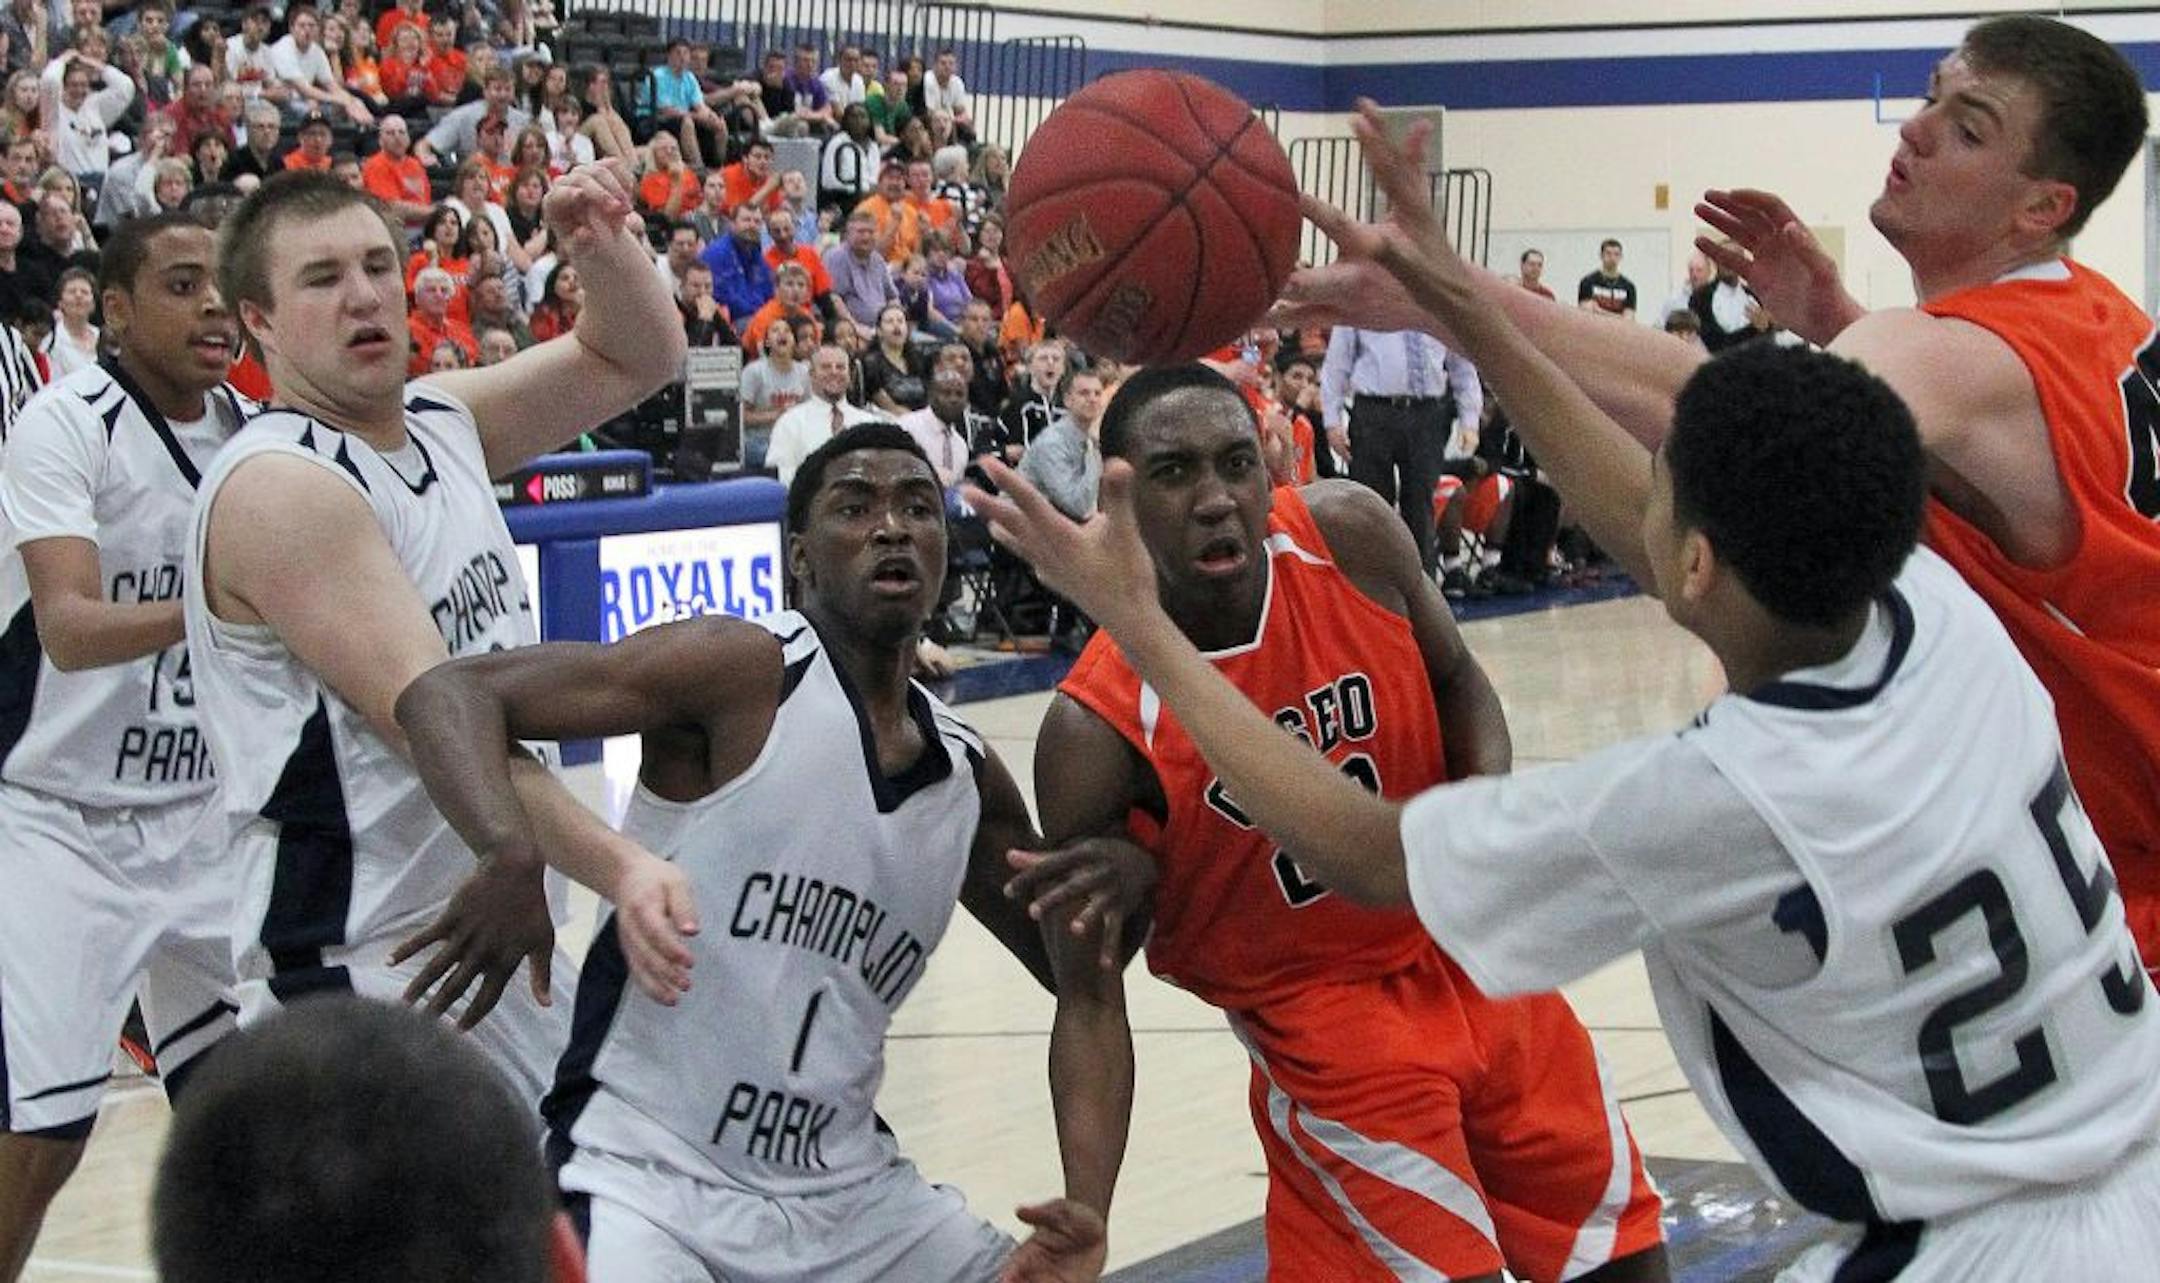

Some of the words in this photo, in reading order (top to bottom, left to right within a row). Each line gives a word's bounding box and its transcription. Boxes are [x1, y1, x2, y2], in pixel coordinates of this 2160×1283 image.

[543, 474, 576, 500] POSS
[430, 550, 530, 656] CHAMP
[601, 554, 773, 644] ROYALS
[729, 871, 923, 1005] CHAMPLIN
[1891, 756, 2146, 1126] 25
[792, 988, 823, 1073] 1
[711, 1082, 838, 1170] PARK
